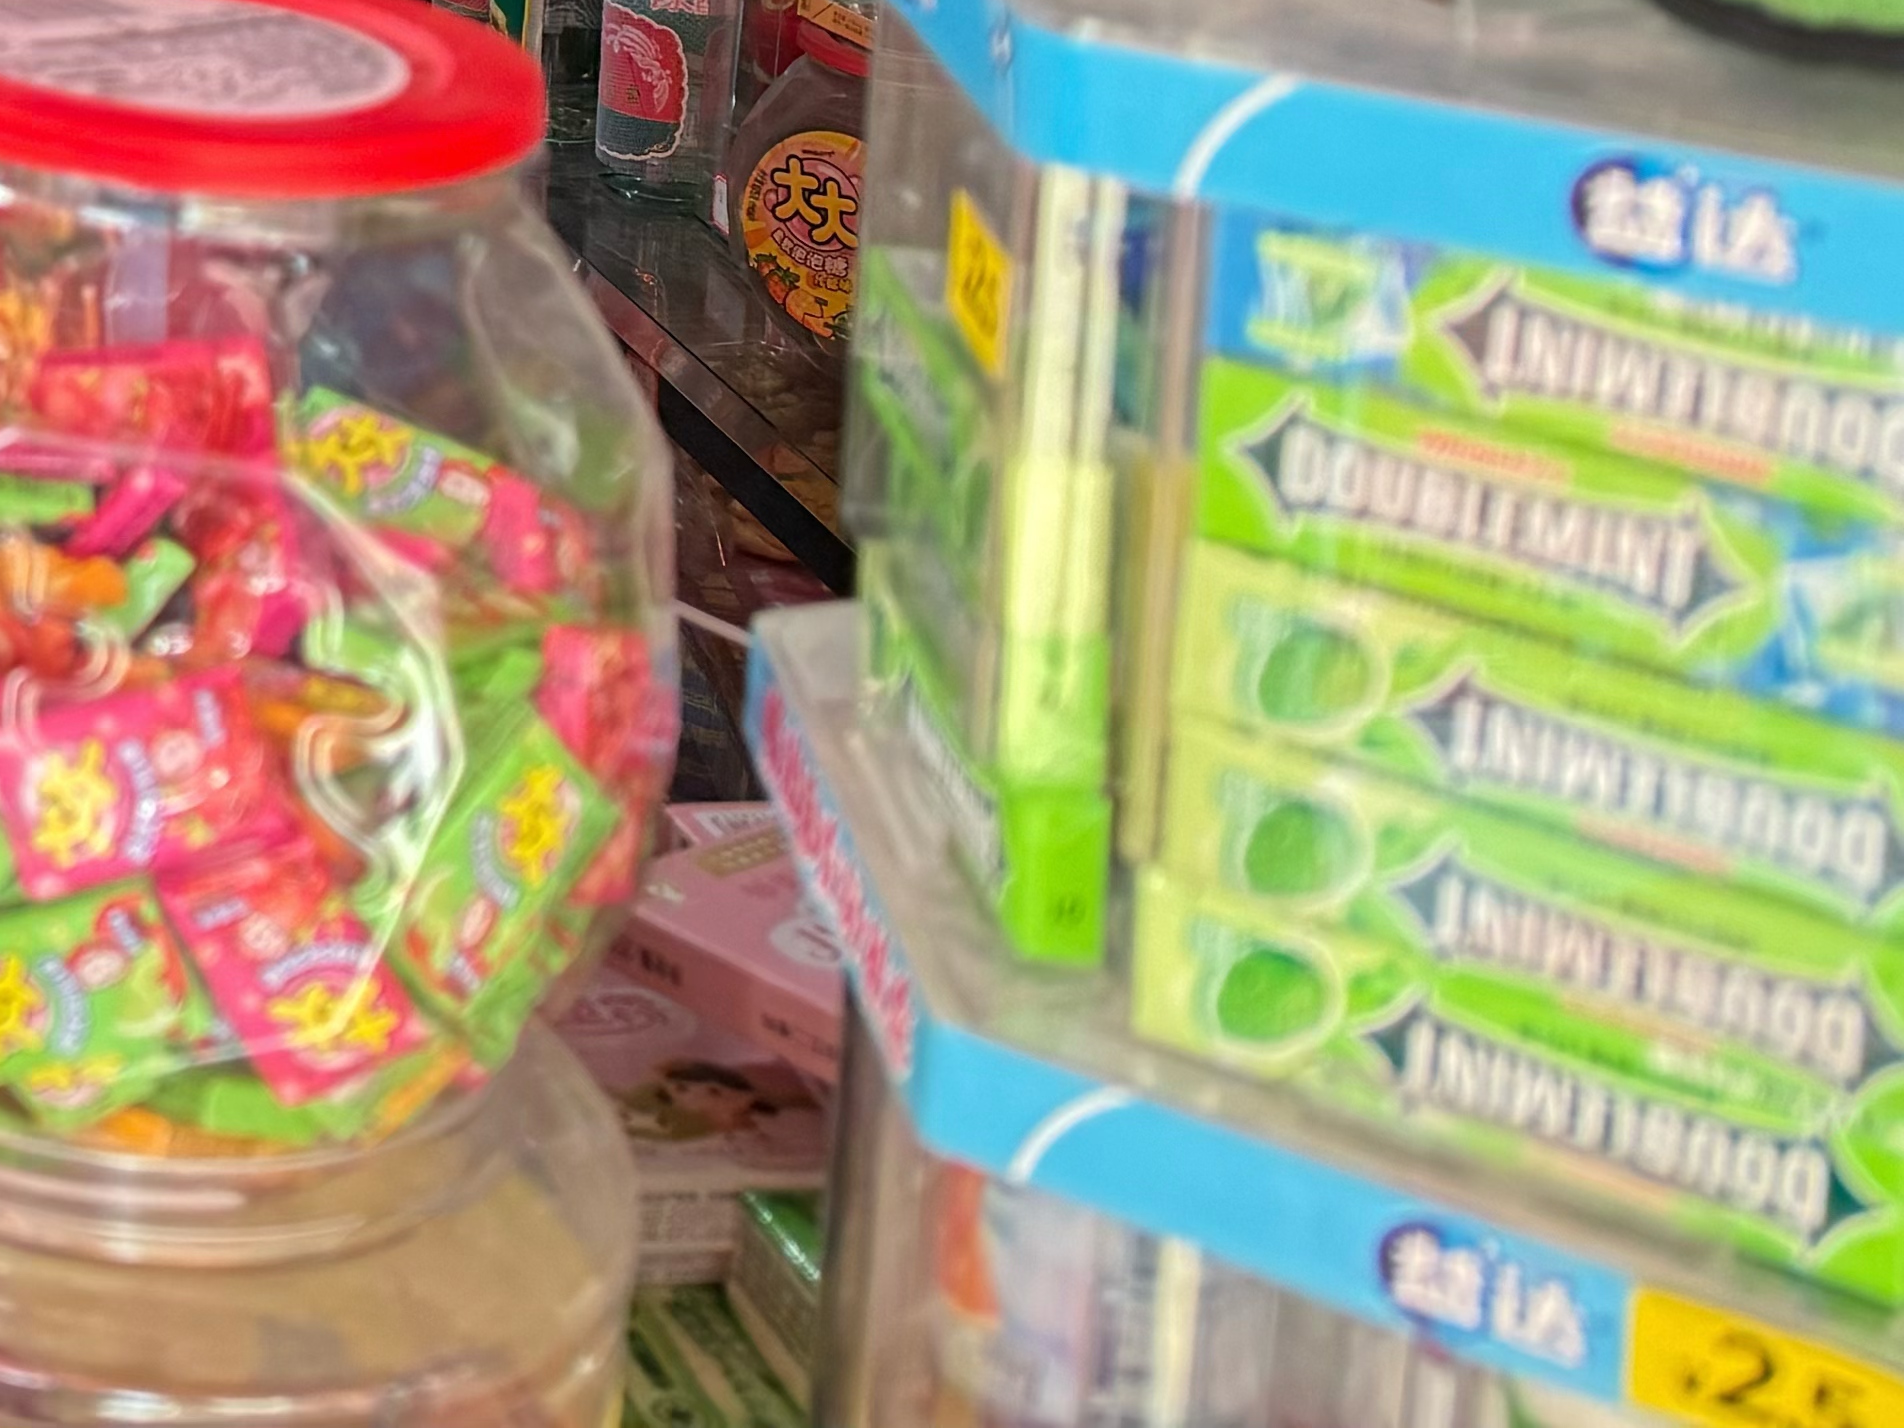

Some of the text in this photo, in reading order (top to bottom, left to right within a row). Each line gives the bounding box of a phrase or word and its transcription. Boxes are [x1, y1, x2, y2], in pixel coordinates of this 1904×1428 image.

[771, 155, 860, 252] 大大
[1278, 424, 1698, 614] DOUBLEMINT
[1454, 690, 1889, 894] DOUBLEMINT
[1432, 868, 1872, 1086] DOUBLEMINT
[1402, 1024, 1837, 1232] DOUBLEMINT
